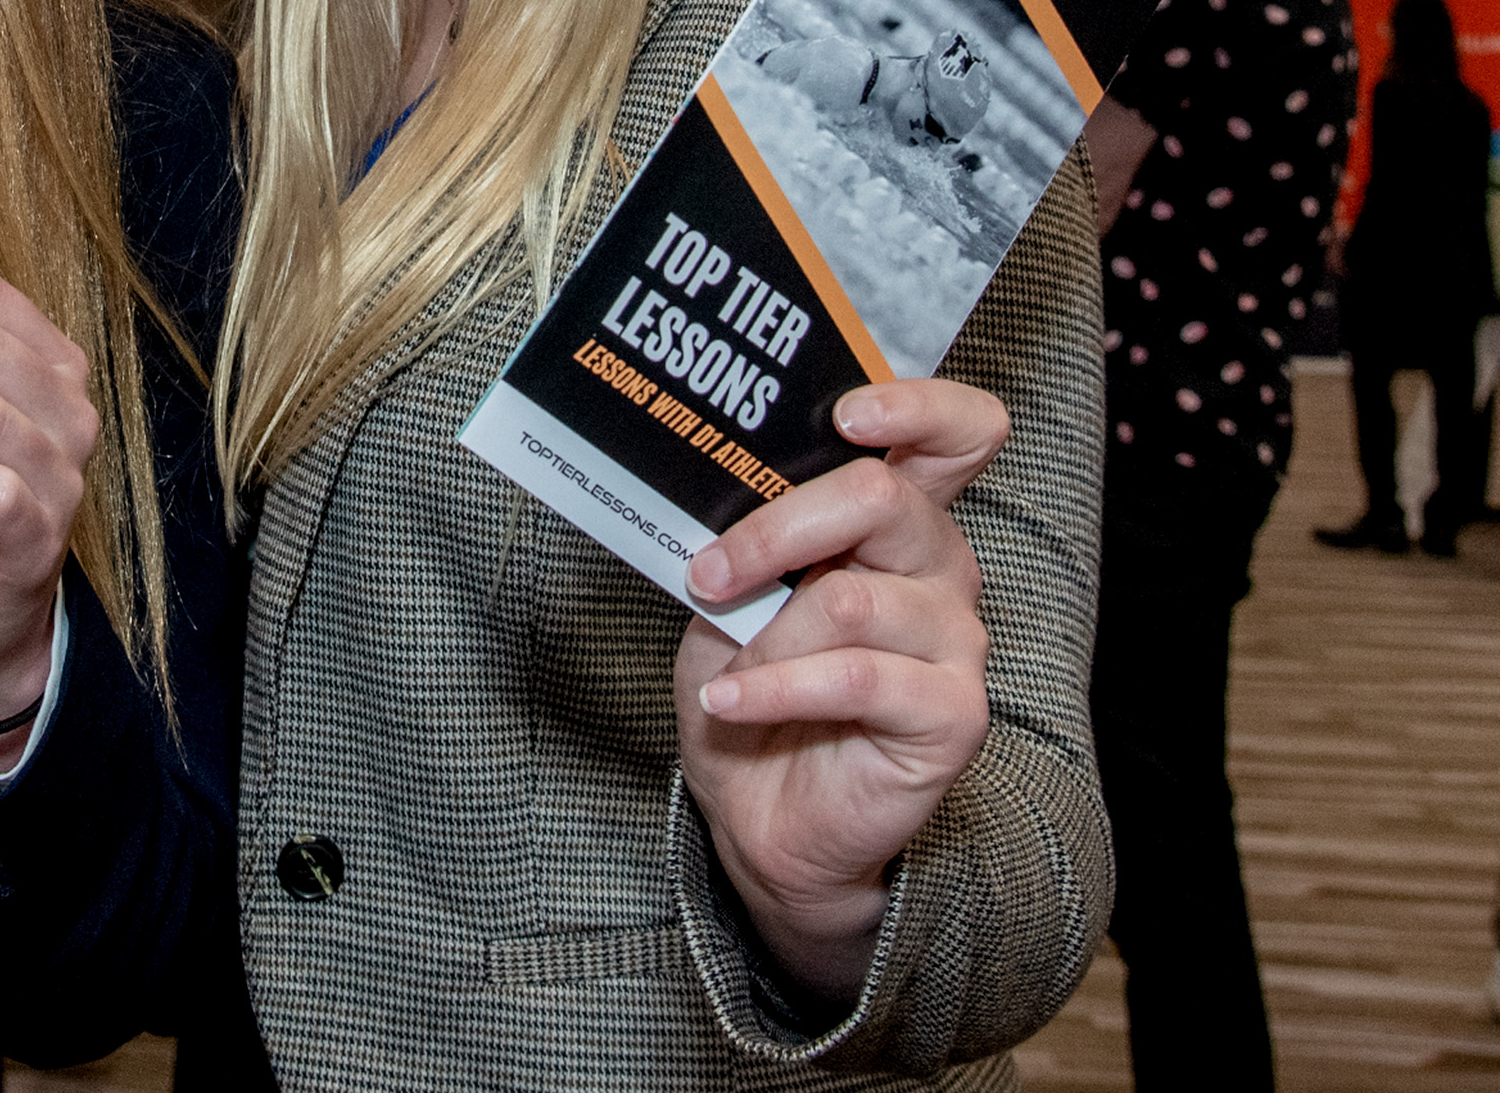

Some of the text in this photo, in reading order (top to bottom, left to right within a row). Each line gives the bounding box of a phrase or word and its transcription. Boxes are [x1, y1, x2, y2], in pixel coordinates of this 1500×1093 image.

[601, 275, 782, 432] LESSONS
[645, 211, 812, 368] TOP TIER
[572, 338, 659, 406] LESSONS
[647, 391, 703, 438] WITH
[689, 423, 724, 454] D1
[521, 430, 695, 562] TOPTIERLESSONS.COM
